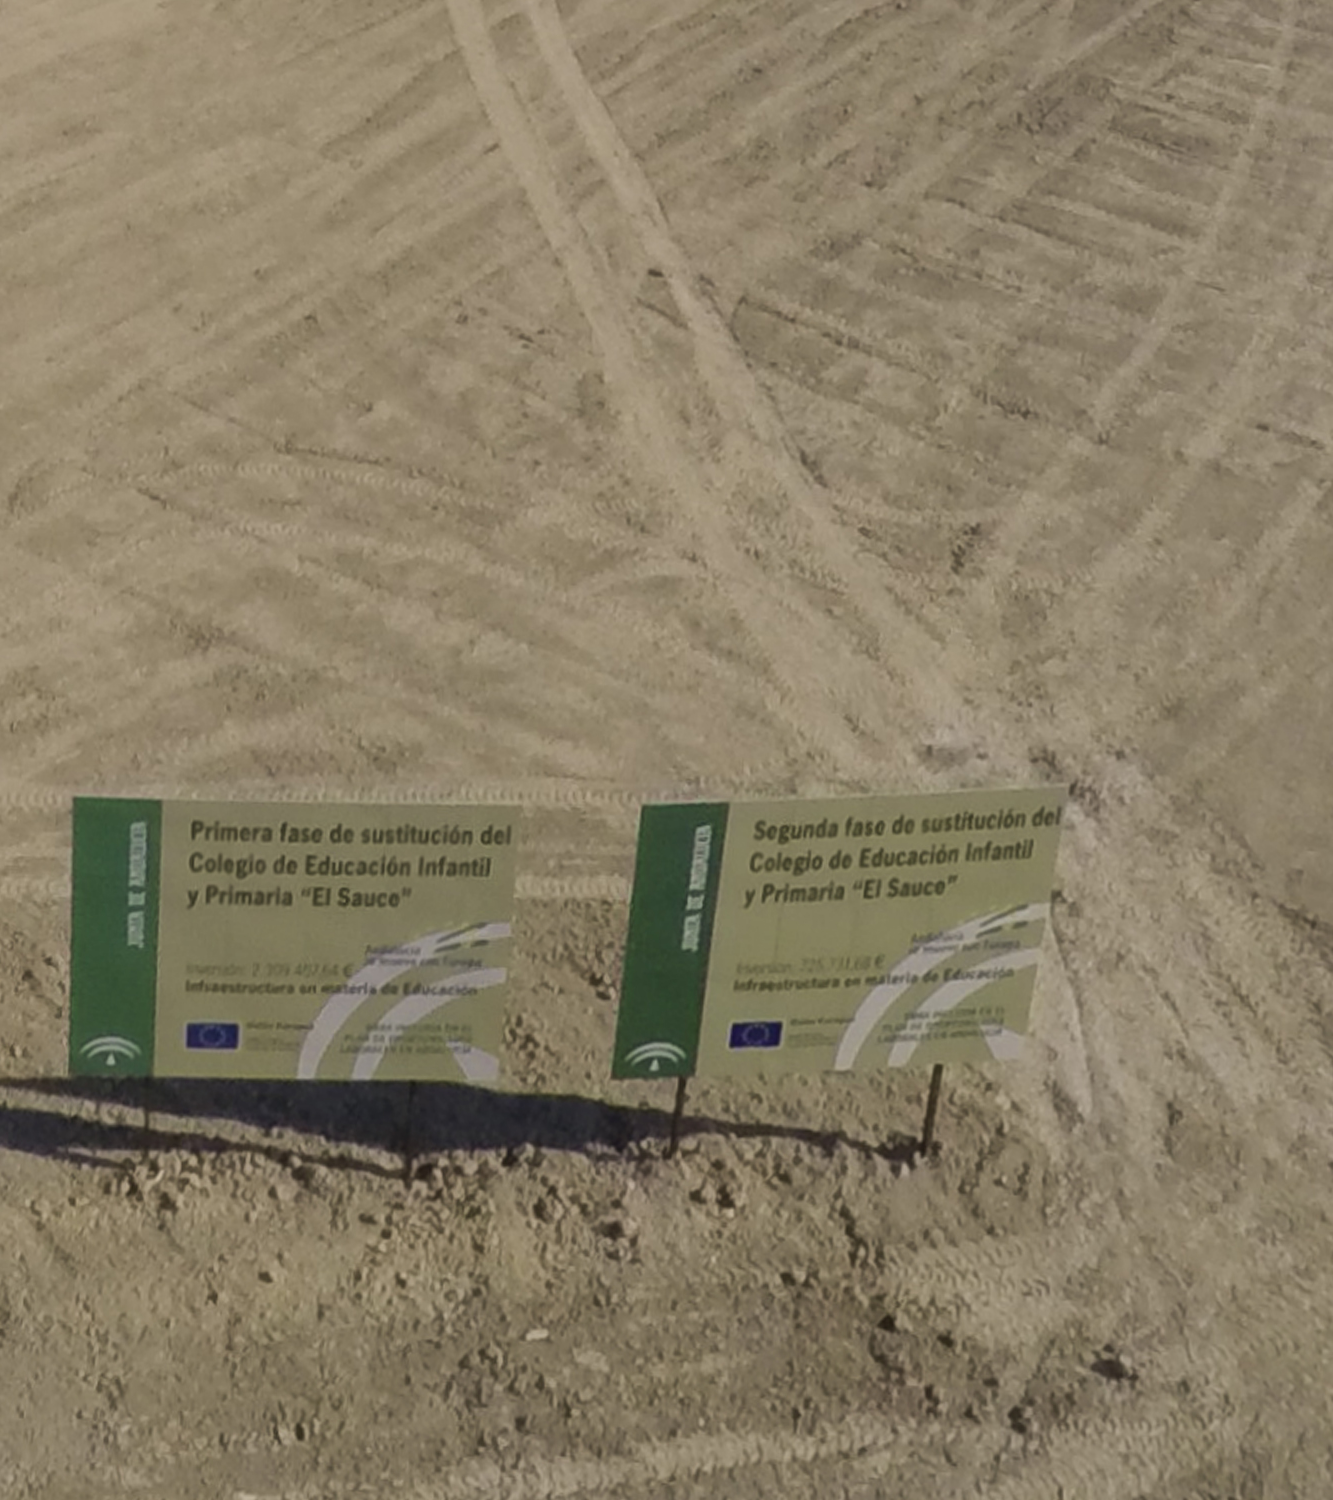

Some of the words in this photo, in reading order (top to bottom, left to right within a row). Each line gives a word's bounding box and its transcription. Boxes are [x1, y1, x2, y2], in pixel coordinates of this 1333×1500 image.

[190, 820, 273, 843] Primera
[280, 821, 324, 844] fase
[329, 823, 354, 845] de
[361, 823, 473, 845] sustitución
[480, 824, 512, 845] del
[753, 818, 839, 845] Segunda
[845, 816, 887, 838] fase
[892, 814, 916, 835] de
[921, 809, 1027, 834] sustitución
[1031, 805, 1062, 827] del
[189, 852, 267, 879] Colegio
[273, 854, 298, 875] de
[305, 853, 411, 877] Educación
[419, 855, 492, 877] Infantil
[749, 849, 823, 876] Colegio
[829, 849, 853, 871] de
[859, 843, 960, 869] Educación
[965, 839, 1034, 863] Infantil
[187, 889, 199, 909] y
[206, 884, 293, 906] Primaria
[743, 888, 756, 909] y
[761, 880, 846, 904] Primaria
